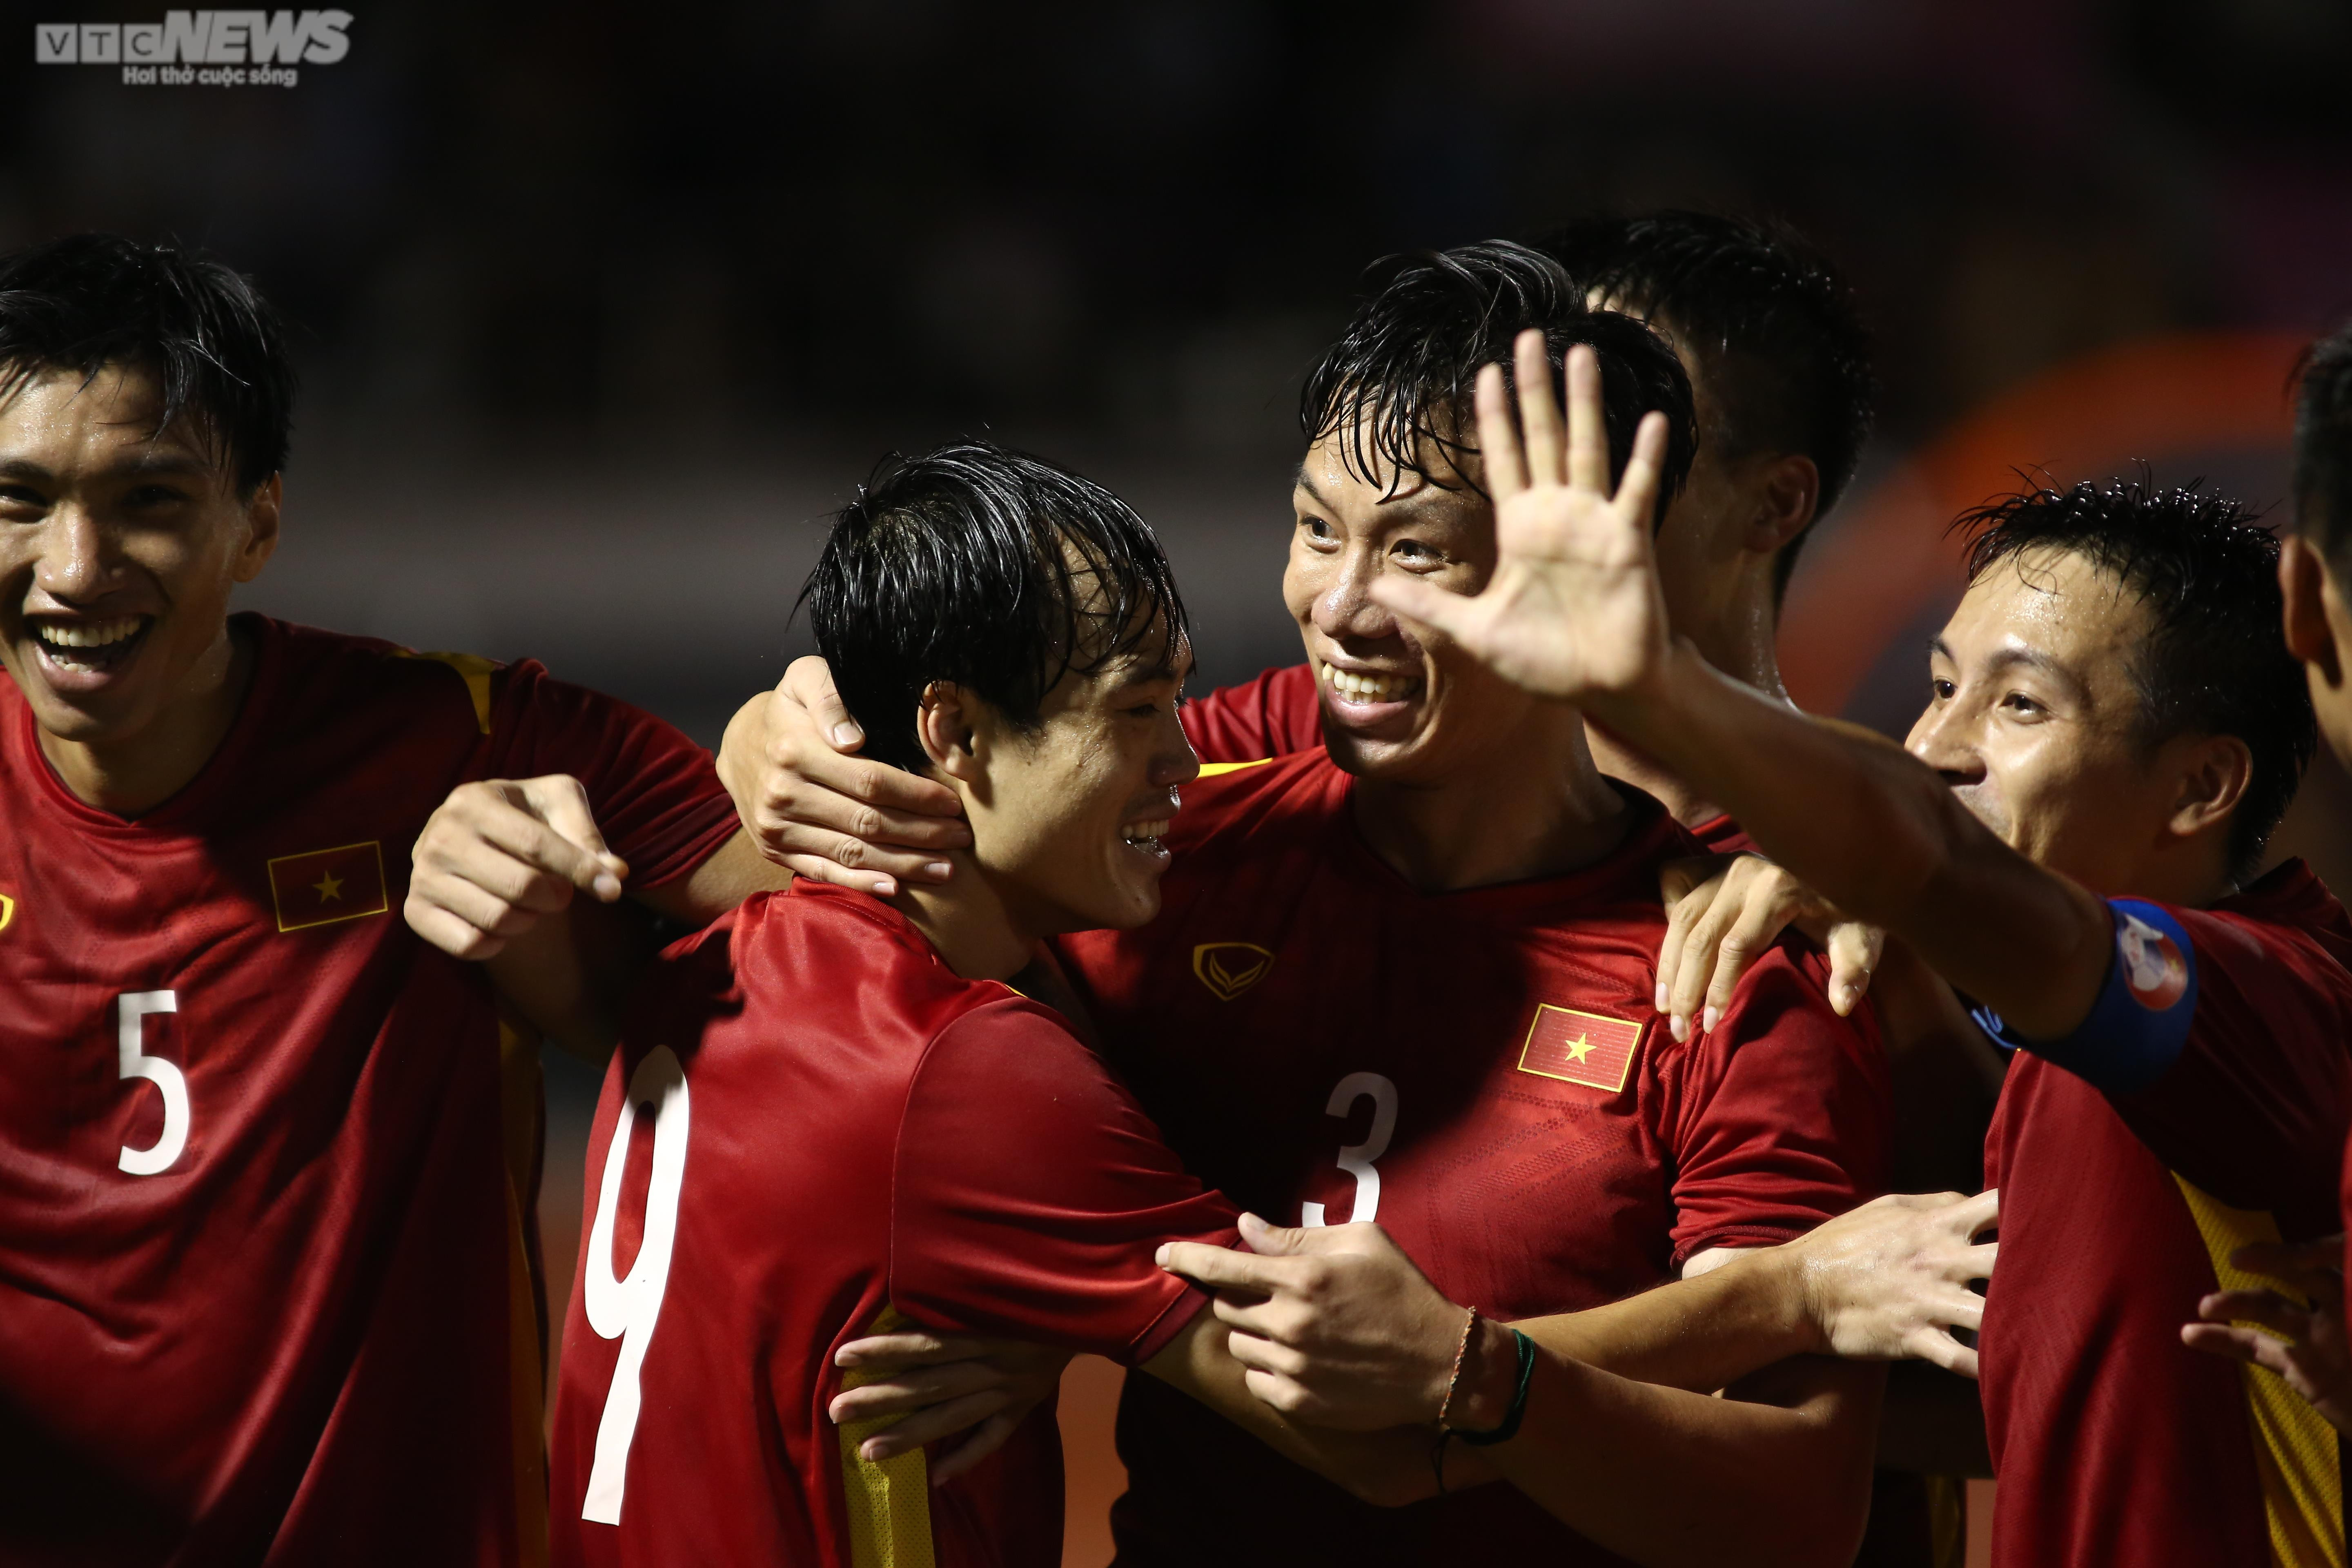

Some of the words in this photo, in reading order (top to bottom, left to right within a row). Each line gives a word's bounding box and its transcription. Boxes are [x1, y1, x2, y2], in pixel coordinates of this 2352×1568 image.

[118, 989, 190, 1176] 5
[1301, 1071, 1399, 1227] 3
[581, 1044, 690, 1527] 9
